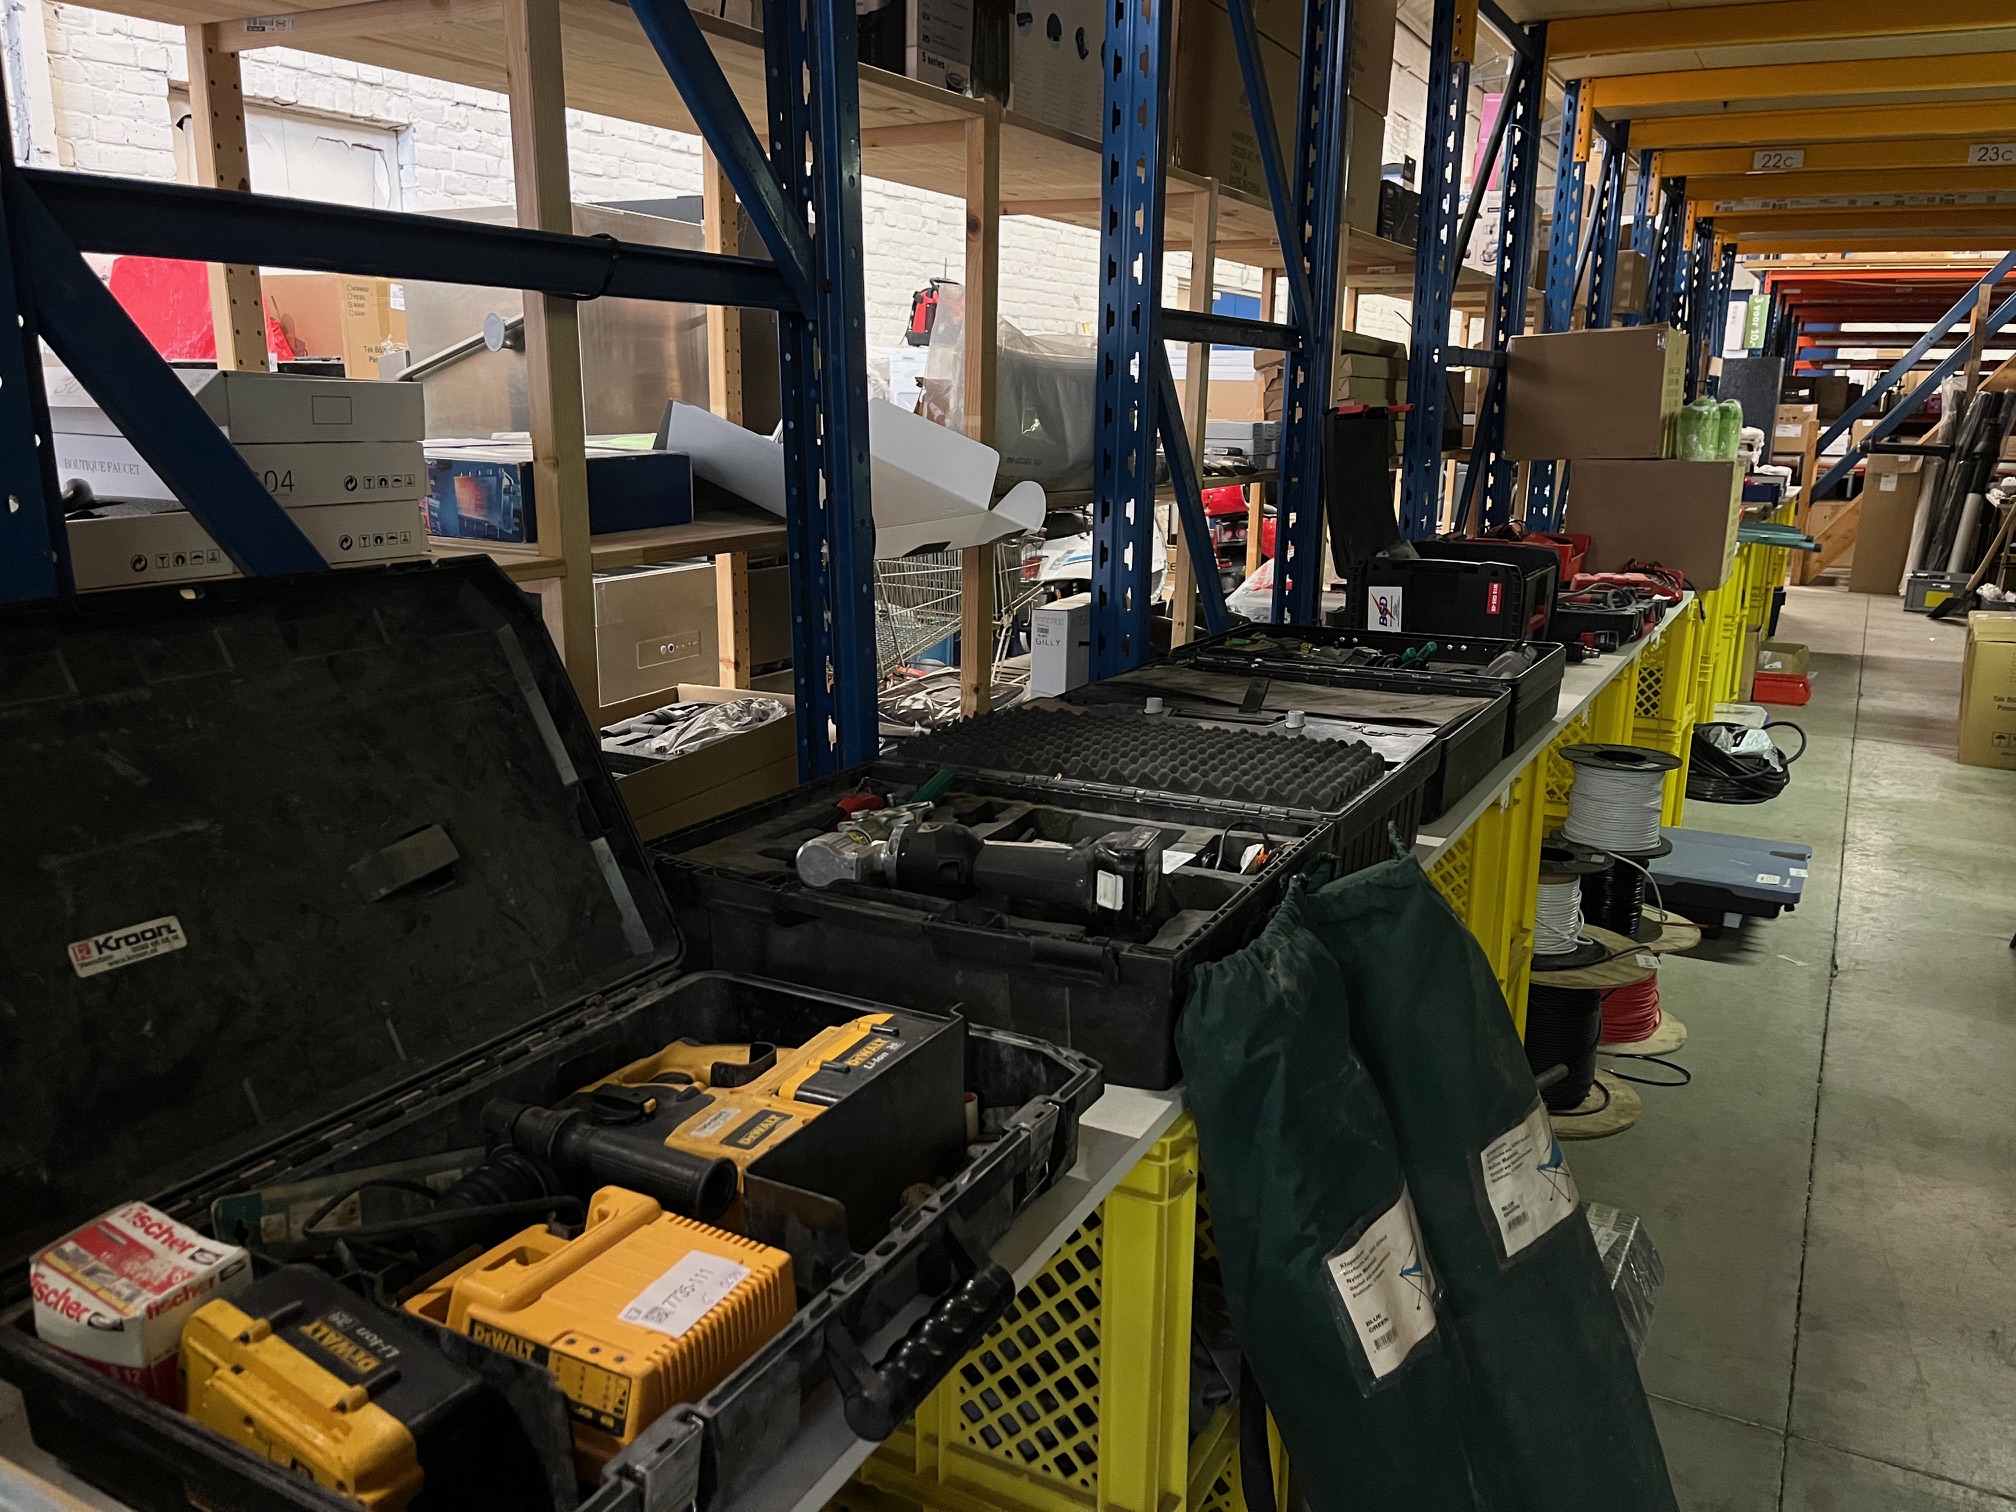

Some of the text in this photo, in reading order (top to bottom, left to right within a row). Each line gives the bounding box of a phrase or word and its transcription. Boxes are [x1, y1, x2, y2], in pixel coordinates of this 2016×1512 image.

[927, 56, 945, 70] series
[1751, 304, 1762, 327] voor
[64, 458, 140, 475] BOUTIQUE FAUCET
[1378, 596, 1388, 627] BSD
[1035, 638, 1061, 647] GILLY
[93, 923, 177, 955] Kroon
[1346, 1272, 1363, 1284] Nylon
[31, 1271, 92, 1323] fischer
[1365, 1313, 1382, 1327] BLUE
[1368, 1317, 1390, 1334] GREEN
